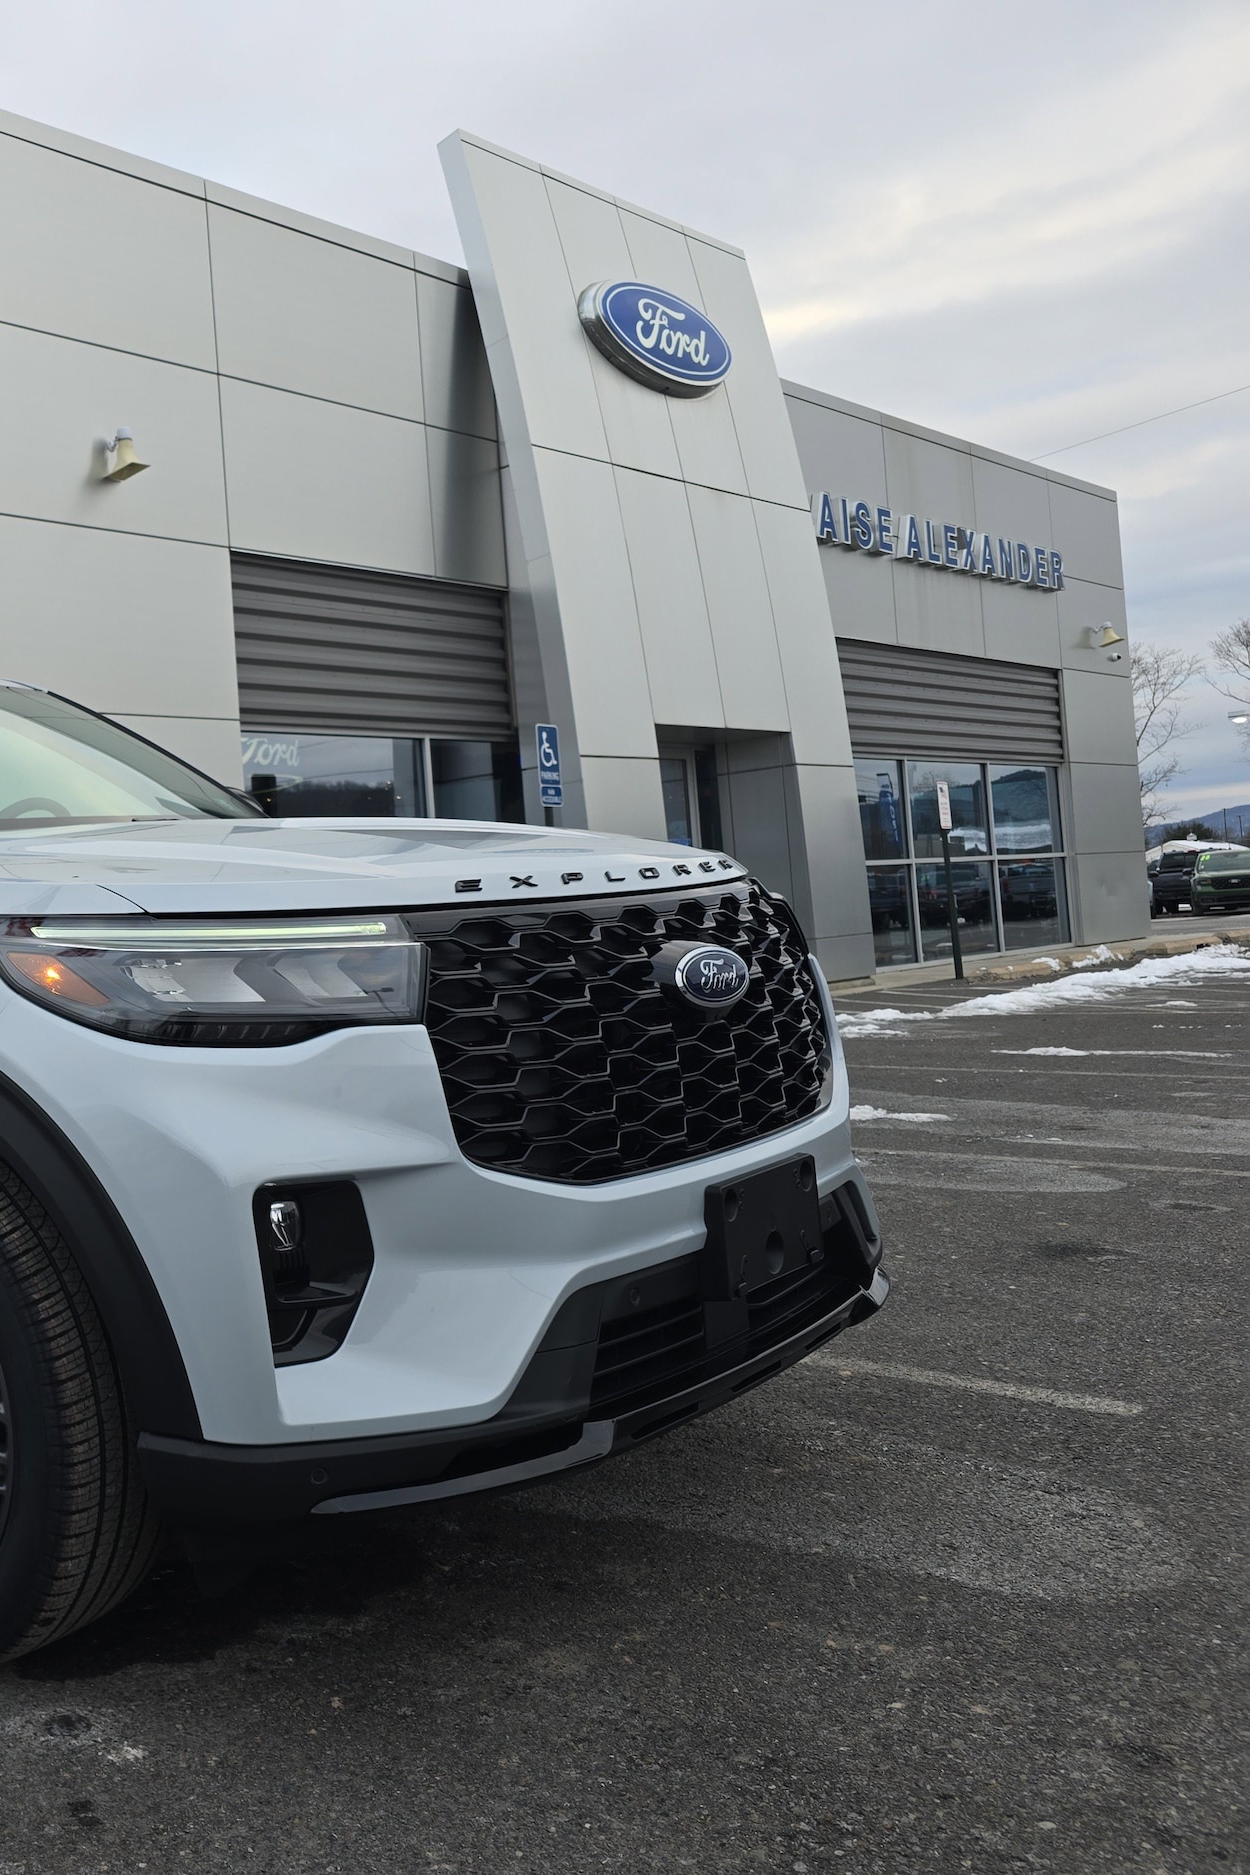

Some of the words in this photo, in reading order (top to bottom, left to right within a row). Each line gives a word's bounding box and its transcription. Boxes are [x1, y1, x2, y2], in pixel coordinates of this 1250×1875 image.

[636, 298, 710, 366] Ford
[816, 491, 894, 554] AISE
[899, 514, 1064, 591] ALEXANDER
[240, 737, 301, 767] Ford
[454, 859, 733, 892] EXPLORER
[700, 958, 739, 993] Ford
